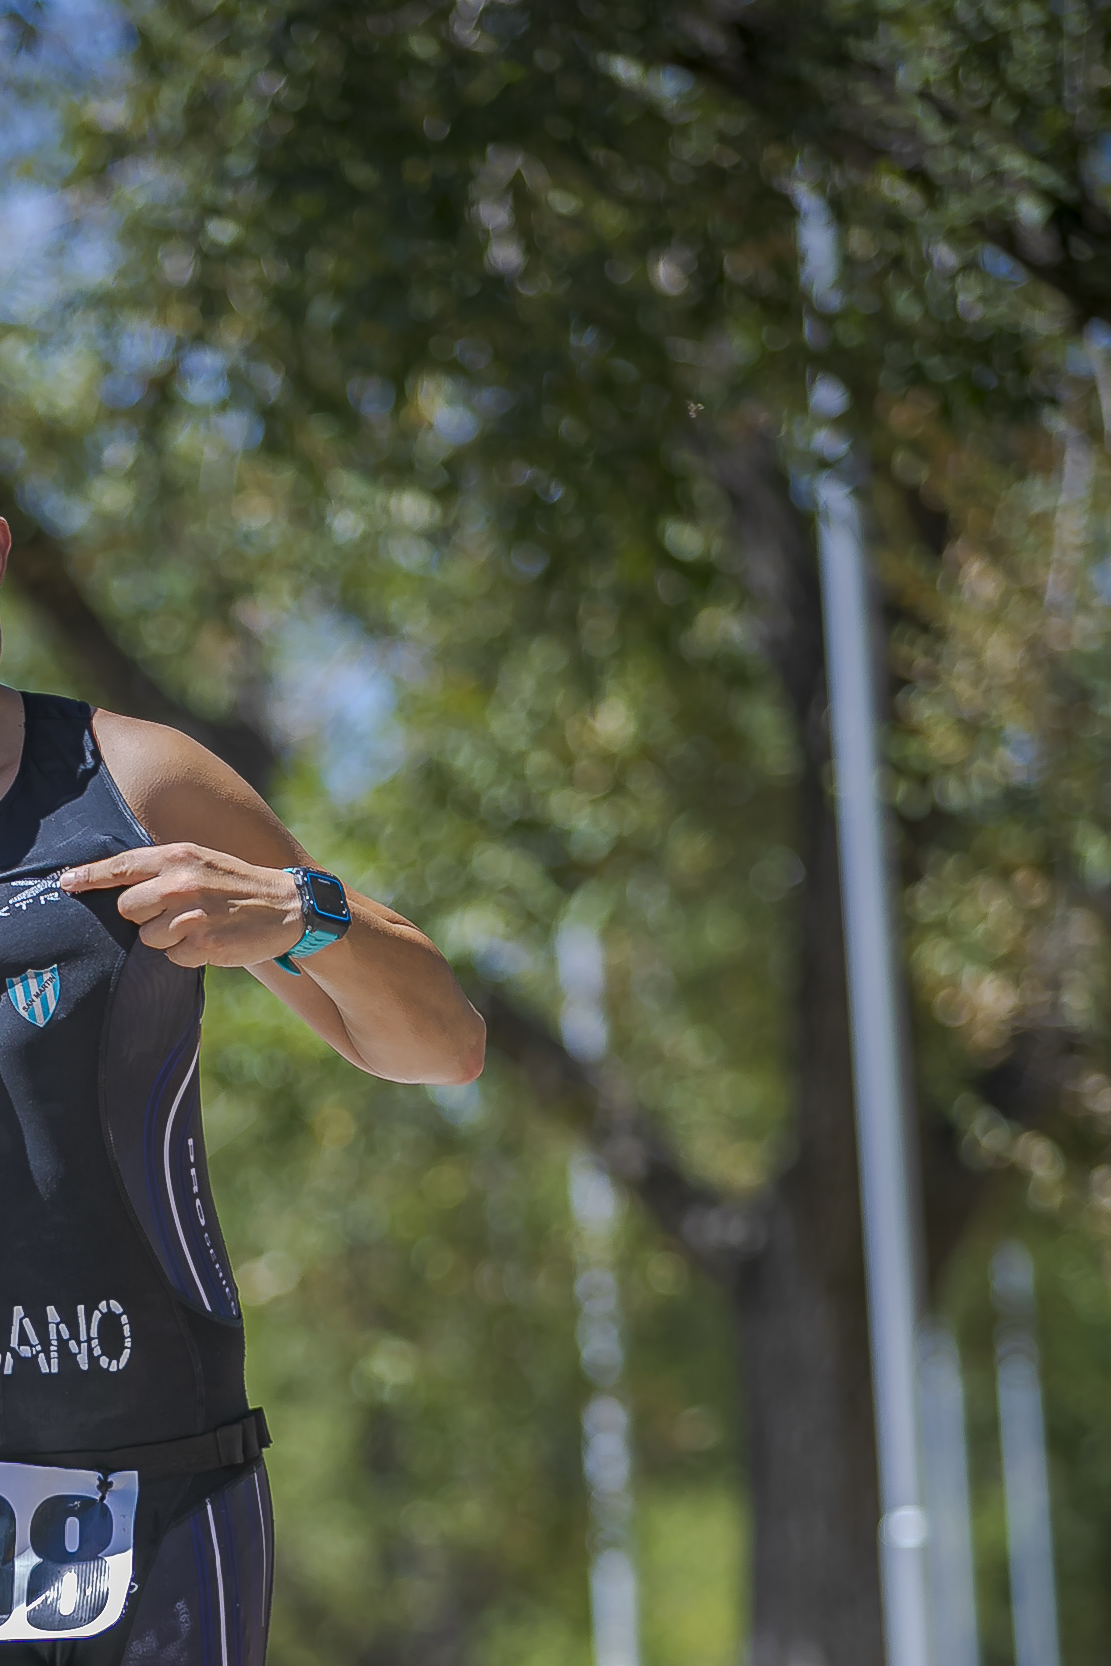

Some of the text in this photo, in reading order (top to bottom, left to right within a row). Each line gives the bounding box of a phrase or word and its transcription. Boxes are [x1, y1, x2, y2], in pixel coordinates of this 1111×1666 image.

[22, 974, 57, 1012] SAN MARTIN
[187, 1137, 206, 1227] PRO
